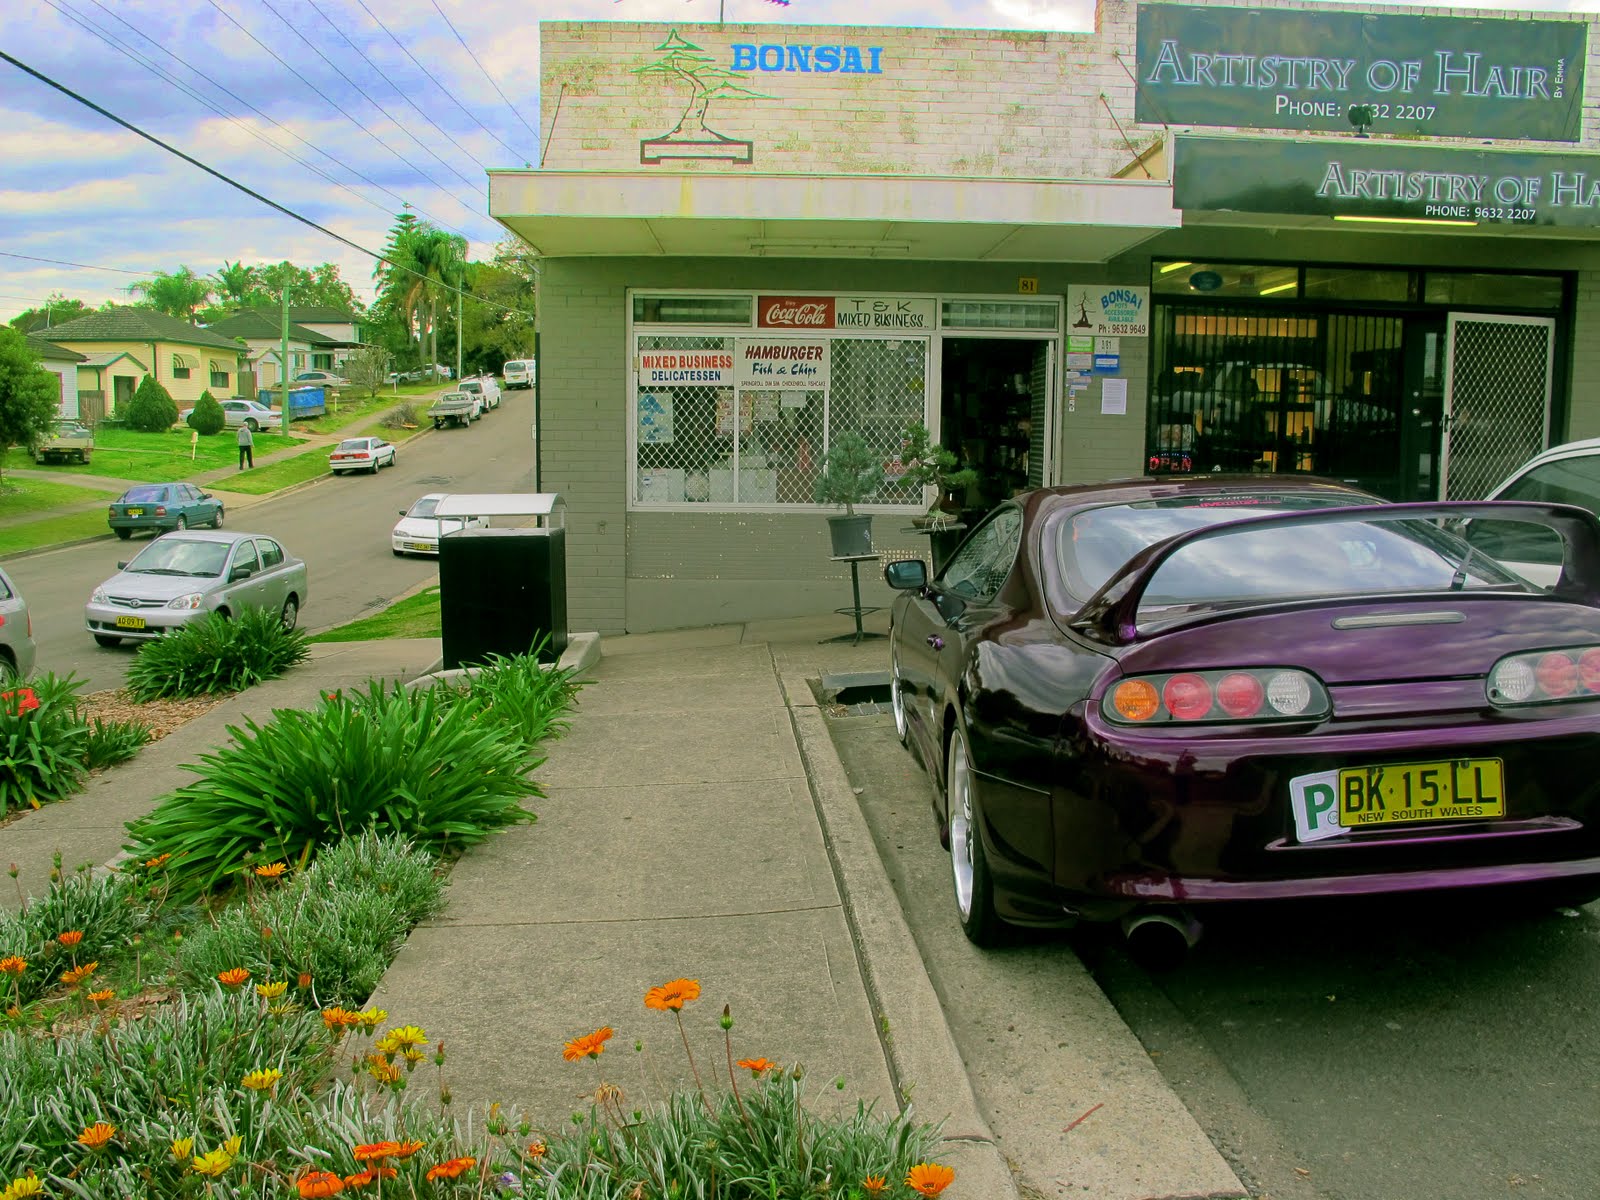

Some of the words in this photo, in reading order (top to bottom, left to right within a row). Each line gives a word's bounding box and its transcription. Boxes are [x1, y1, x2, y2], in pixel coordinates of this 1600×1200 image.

[730, 43, 884, 75] BONSAI
[1146, 39, 1356, 91] ARTISTRY
[1366, 59, 1422, 93] OF
[1433, 50, 1551, 100] HAIR
[1554, 58, 1565, 84] EMMA
[1553, 85, 1564, 98] BY
[1275, 94, 1341, 117] PHONE:
[1348, 103, 1390, 119] 32
[1395, 104, 1436, 121] 2207
[1316, 161, 1487, 203] ARTISTRY
[1494, 175, 1542, 206] OF
[1425, 205, 1471, 218] PHONE:
[1474, 206, 1504, 219] 9632
[1507, 207, 1537, 221] 2207
[1021, 279, 1034, 291] 81
[851, 299, 866, 312] T
[872, 301, 890, 312] &
[897, 300, 912, 313] K
[1101, 289, 1143, 310] BONSAI
[765, 303, 828, 325] Coca-Cola
[837, 312, 871, 327] MIXED
[1112, 324, 1128, 334] 9632
[1129, 324, 1146, 335] 9649
[745, 345, 824, 361] HAMBURGER
[642, 355, 676, 369] MIXED
[679, 355, 733, 369] BUSINESS
[651, 370, 721, 382] DELICATESSEN
[752, 362, 773, 376] Fish
[776, 366, 788, 375] &
[790, 363, 818, 379] Chips
[1149, 457, 1192, 472] OPEN
[1303, 783, 1335, 831] P
[1358, 812, 1384, 824] NEW
[1391, 808, 1433, 821] SOUTH
[1440, 806, 1483, 818] WALES
